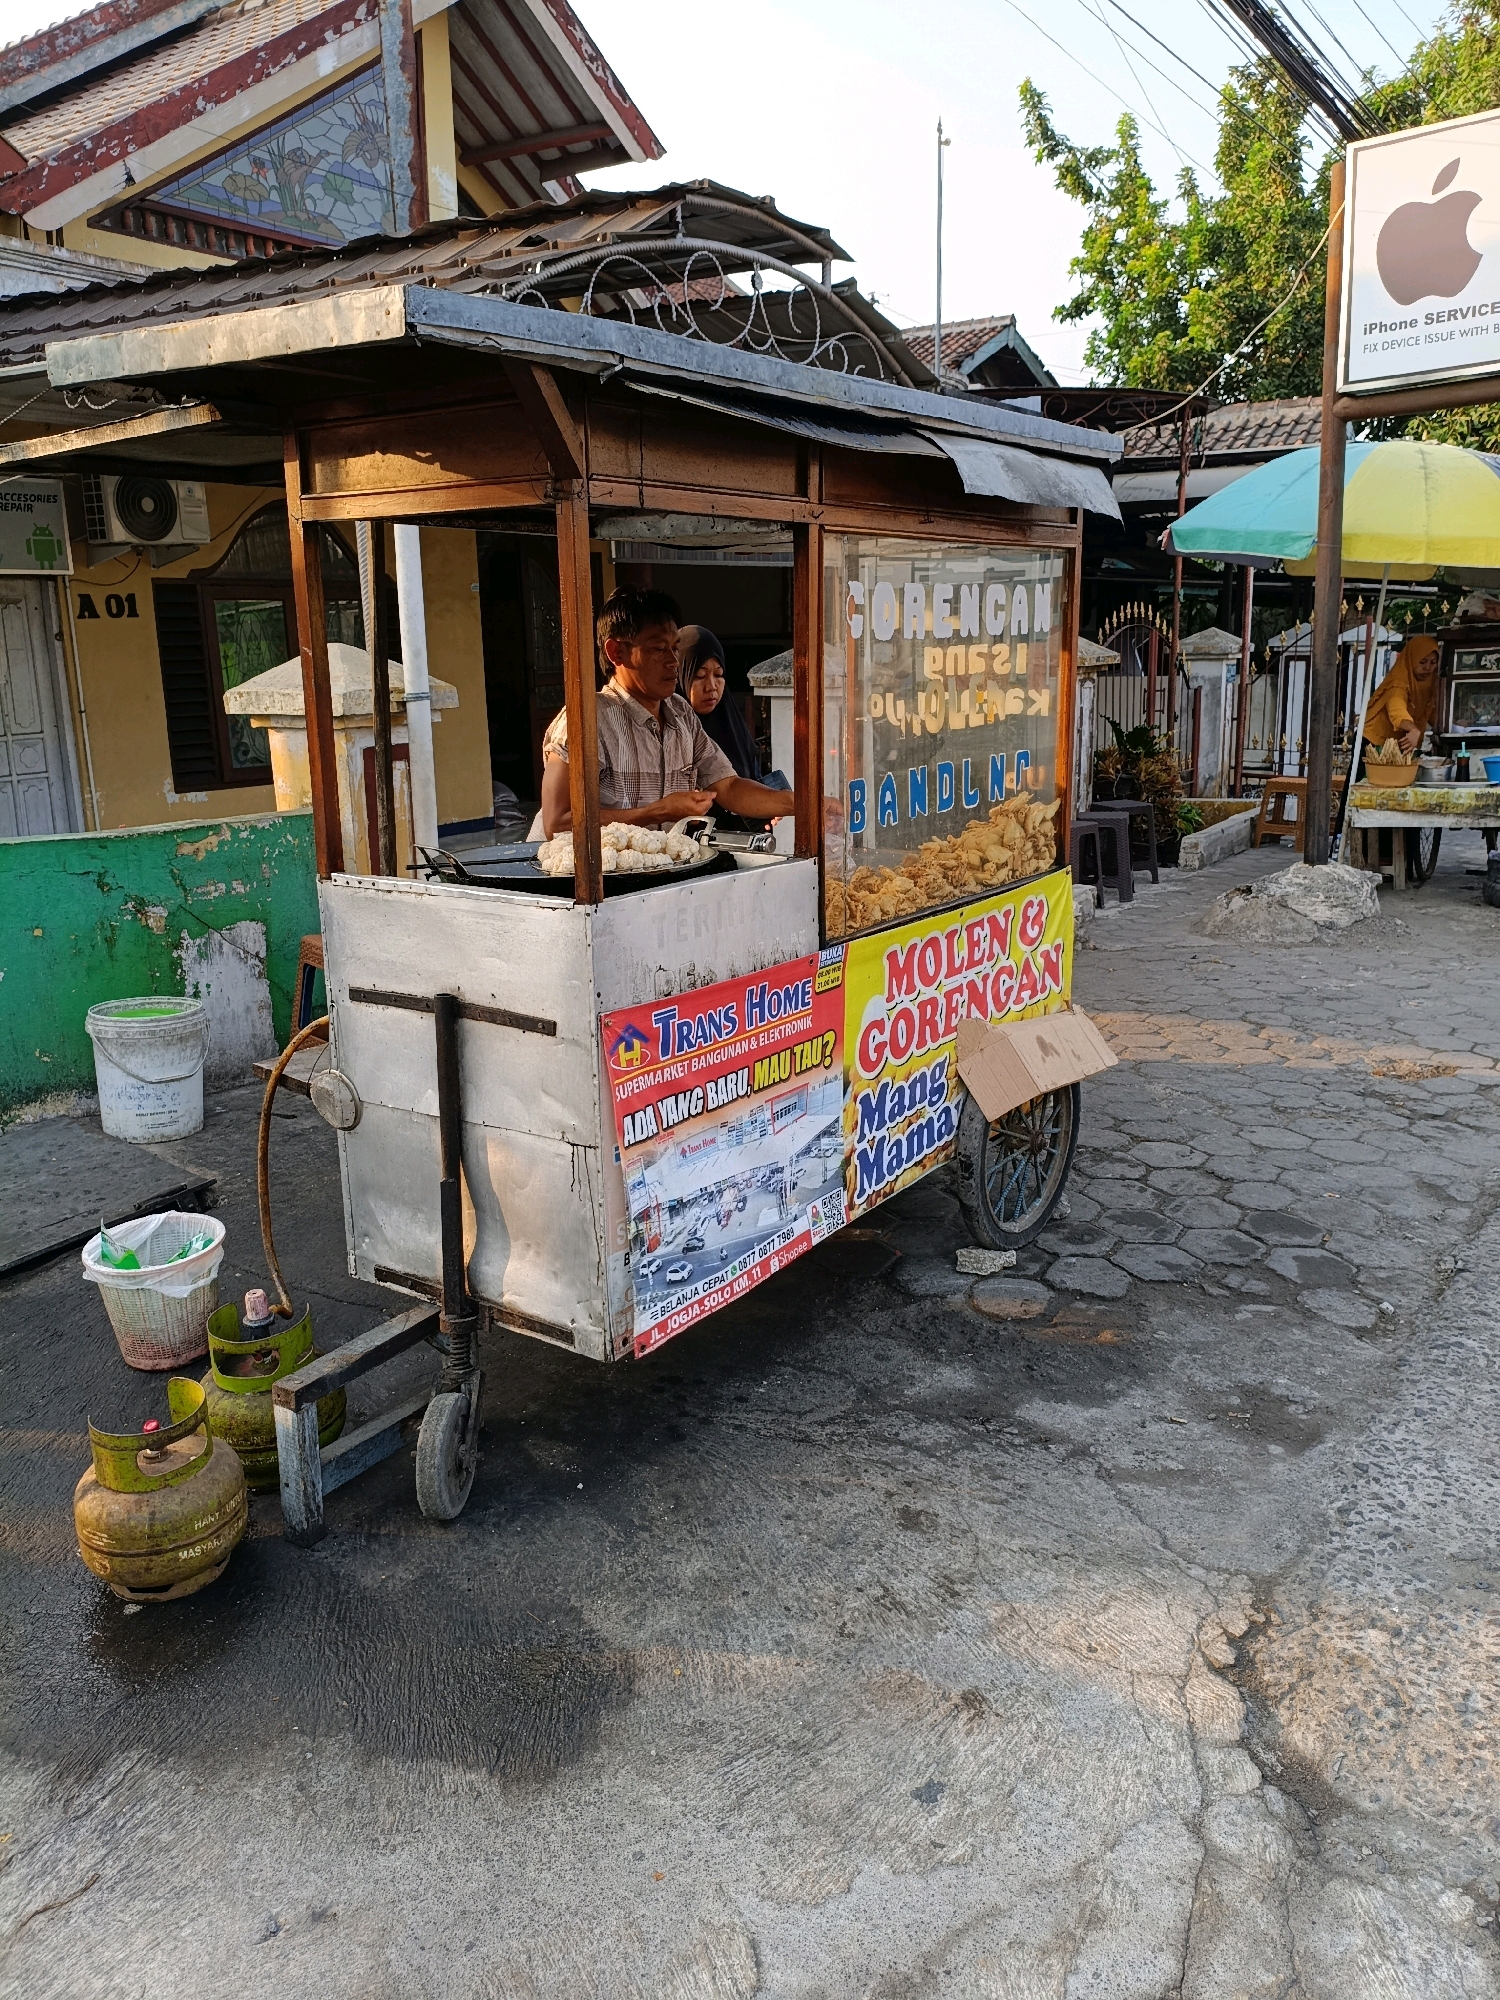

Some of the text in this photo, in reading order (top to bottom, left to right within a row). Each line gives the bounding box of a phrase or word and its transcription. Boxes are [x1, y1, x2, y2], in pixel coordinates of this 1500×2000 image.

[1363, 300, 1500, 336] iPhone SERVICE
[1363, 342, 1379, 354] FIX
[1381, 335, 1421, 351] DEVICE
[1424, 330, 1456, 344] ISSUE
[1459, 323, 1489, 338] WITH
[77, 593, 139, 619] A 01
[821, 945, 843, 962] BUKA
[885, 897, 1046, 1004] MOLEN &
[857, 942, 1064, 1075] GORENGAN
[615, 1016, 813, 1102] SUPERMARKET BANGUNAN & ELEKTRONIK
[622, 1104, 659, 1149] ADA
[656, 1088, 704, 1131] YANG
[705, 1067, 752, 1113] BARU,
[753, 1049, 793, 1092] MAU
[793, 1029, 836, 1074] TAU?
[856, 1055, 948, 1144] Mang
[650, 1327, 665, 1344] JL.
[666, 1287, 731, 1333] JOGJA-SOLO
[733, 1272, 753, 1297] KM.
[752, 1265, 763, 1284] 11
[778, 1240, 808, 1267] Shopee
[660, 1286, 700, 1318] BELANJA
[701, 1270, 730, 1293] CEPAT
[738, 1253, 757, 1272] 0877
[758, 1239, 776, 1259] 0877
[776, 1226, 795, 1246] 7989
